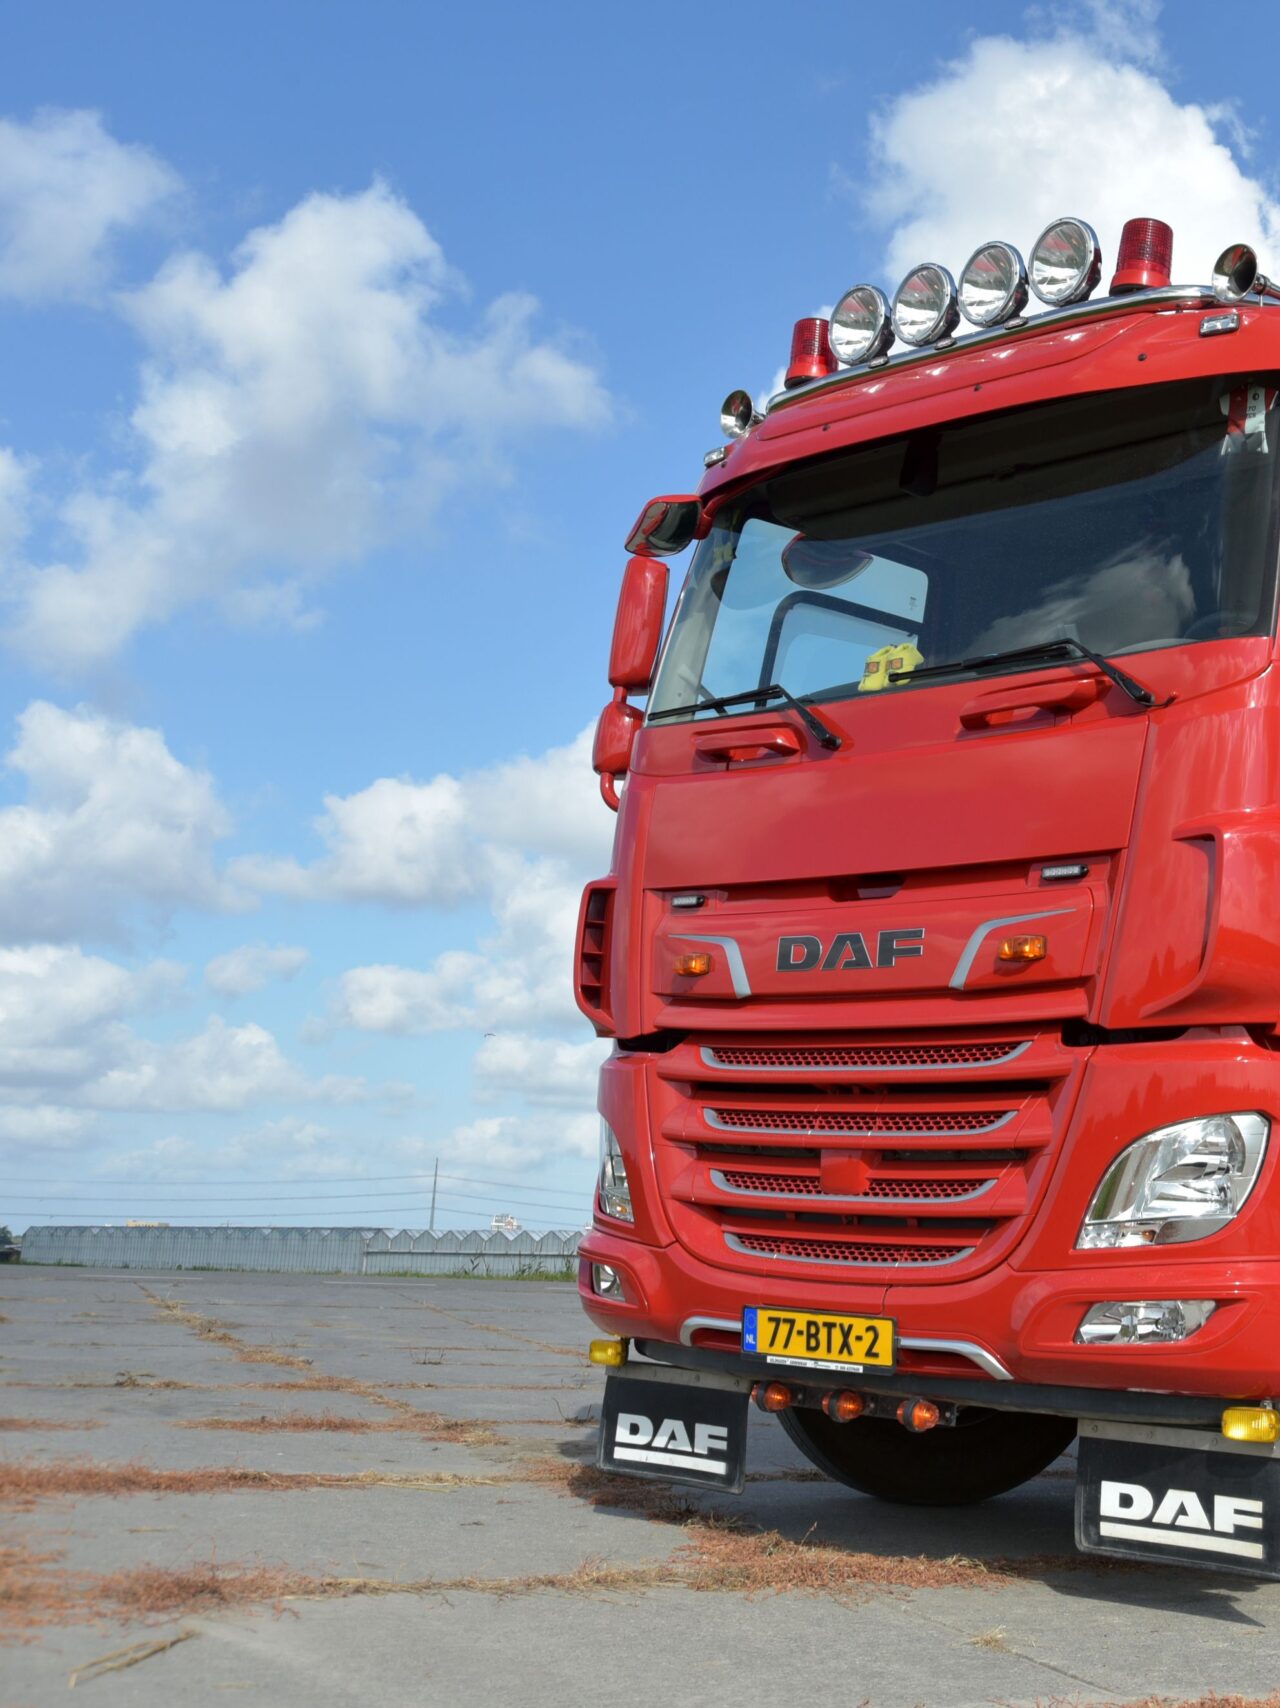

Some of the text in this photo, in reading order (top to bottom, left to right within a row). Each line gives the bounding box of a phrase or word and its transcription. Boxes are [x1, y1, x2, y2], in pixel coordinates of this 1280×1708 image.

[776, 927, 925, 972] DAF
[745, 1333, 756, 1345] NL
[767, 1316, 880, 1359] 77-BTX-2
[616, 1413, 728, 1456] DAF
[1100, 1480, 1264, 1535] DAF
